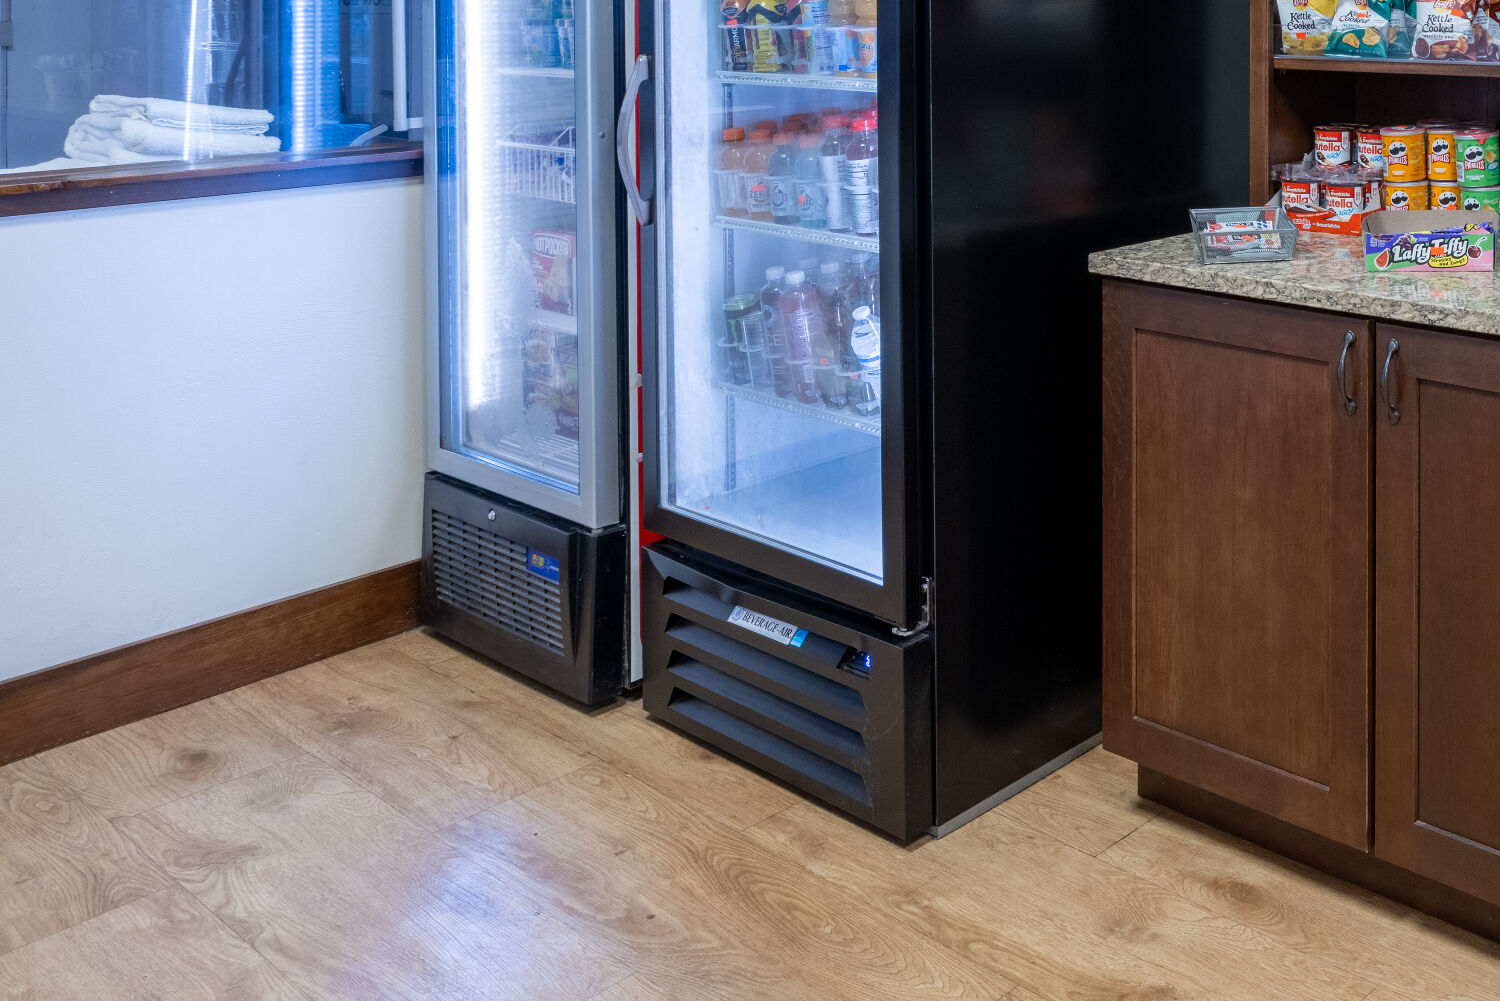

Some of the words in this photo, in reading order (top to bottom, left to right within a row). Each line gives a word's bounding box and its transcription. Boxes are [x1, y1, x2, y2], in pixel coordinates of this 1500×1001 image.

[1434, 0, 1455, 8] Lay's
[1290, 12, 1312, 22] Kettle
[1426, 14, 1453, 24] Kettle
[1287, 22, 1316, 31] Cooked
[1422, 24, 1454, 33] Cooked
[1316, 143, 1340, 152] utella
[1360, 146, 1382, 154] utella
[1432, 154, 1450, 163] PRINGLES
[1464, 160, 1485, 170] PRINGLES
[1284, 196, 1308, 204] utella
[1328, 200, 1352, 208] utella
[1431, 237, 1468, 258] Taffy
[1393, 242, 1431, 264] Laffy
[742, 612, 794, 640] BEVERAGE-AIR
